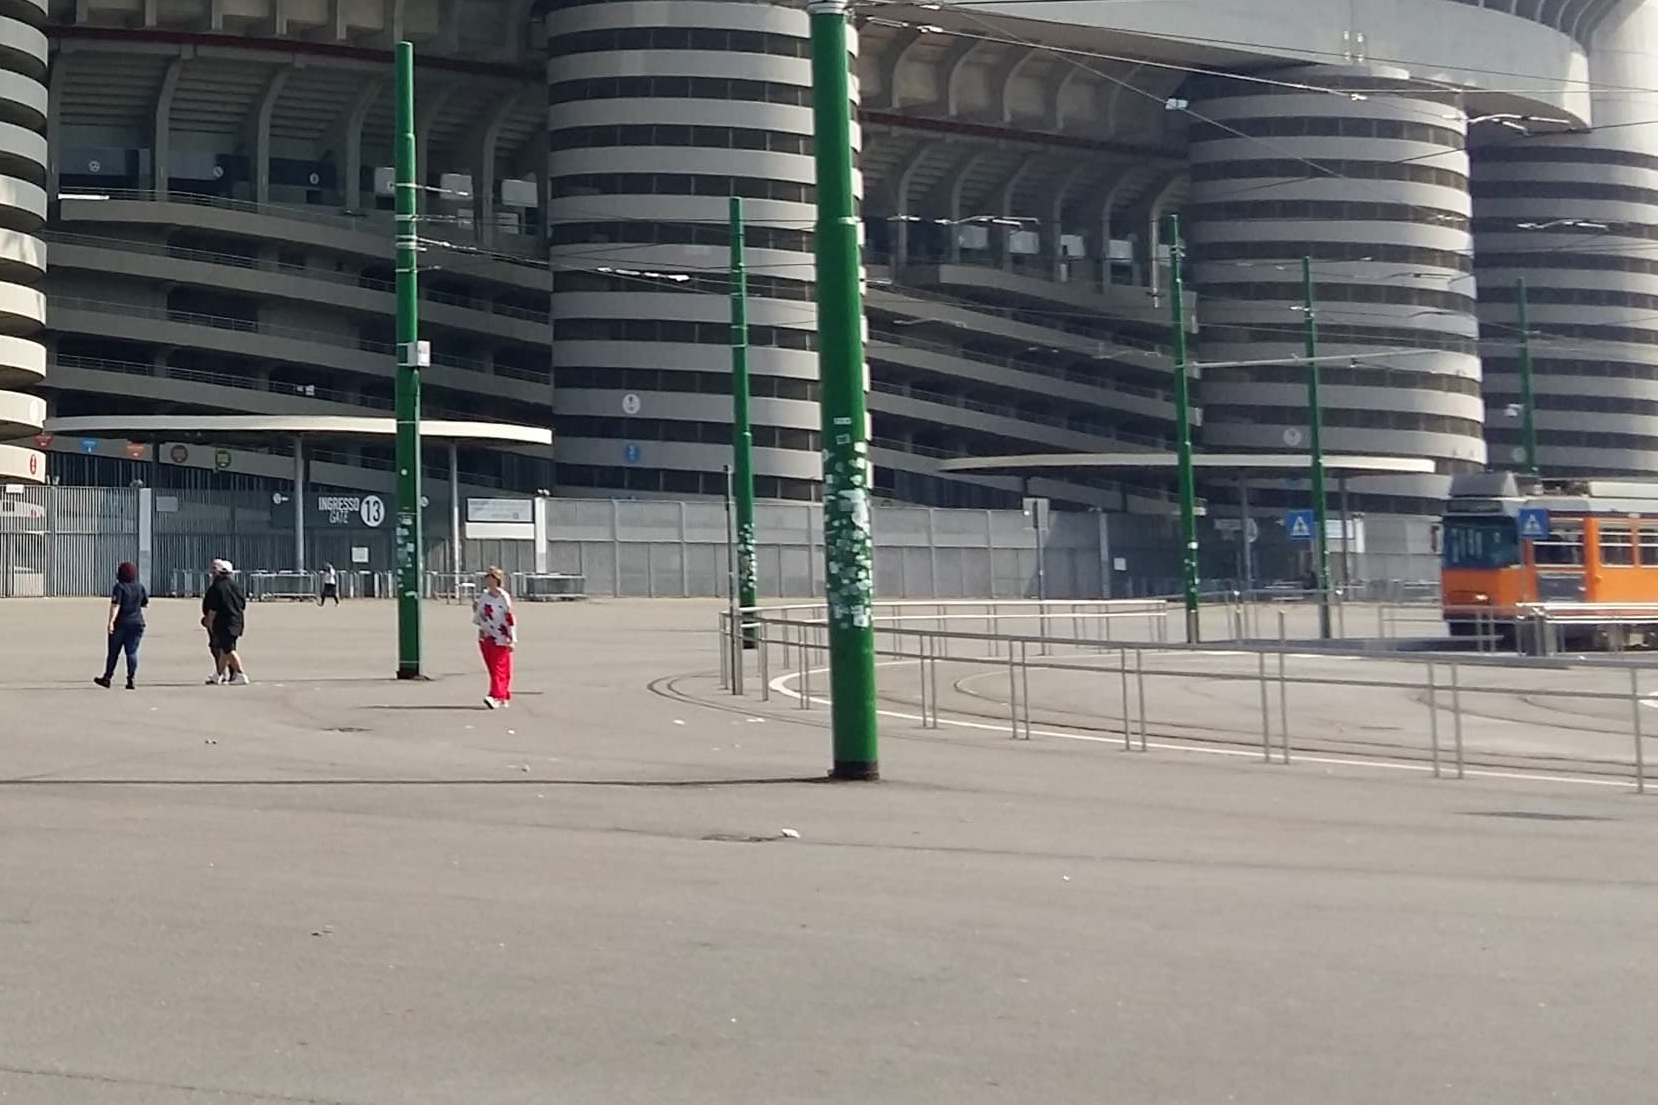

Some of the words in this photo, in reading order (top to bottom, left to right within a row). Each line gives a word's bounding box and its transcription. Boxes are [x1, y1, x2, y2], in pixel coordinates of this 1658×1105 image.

[318, 497, 360, 512] INGRESSO
[365, 500, 382, 523] 13
[329, 510, 349, 524] GATE
